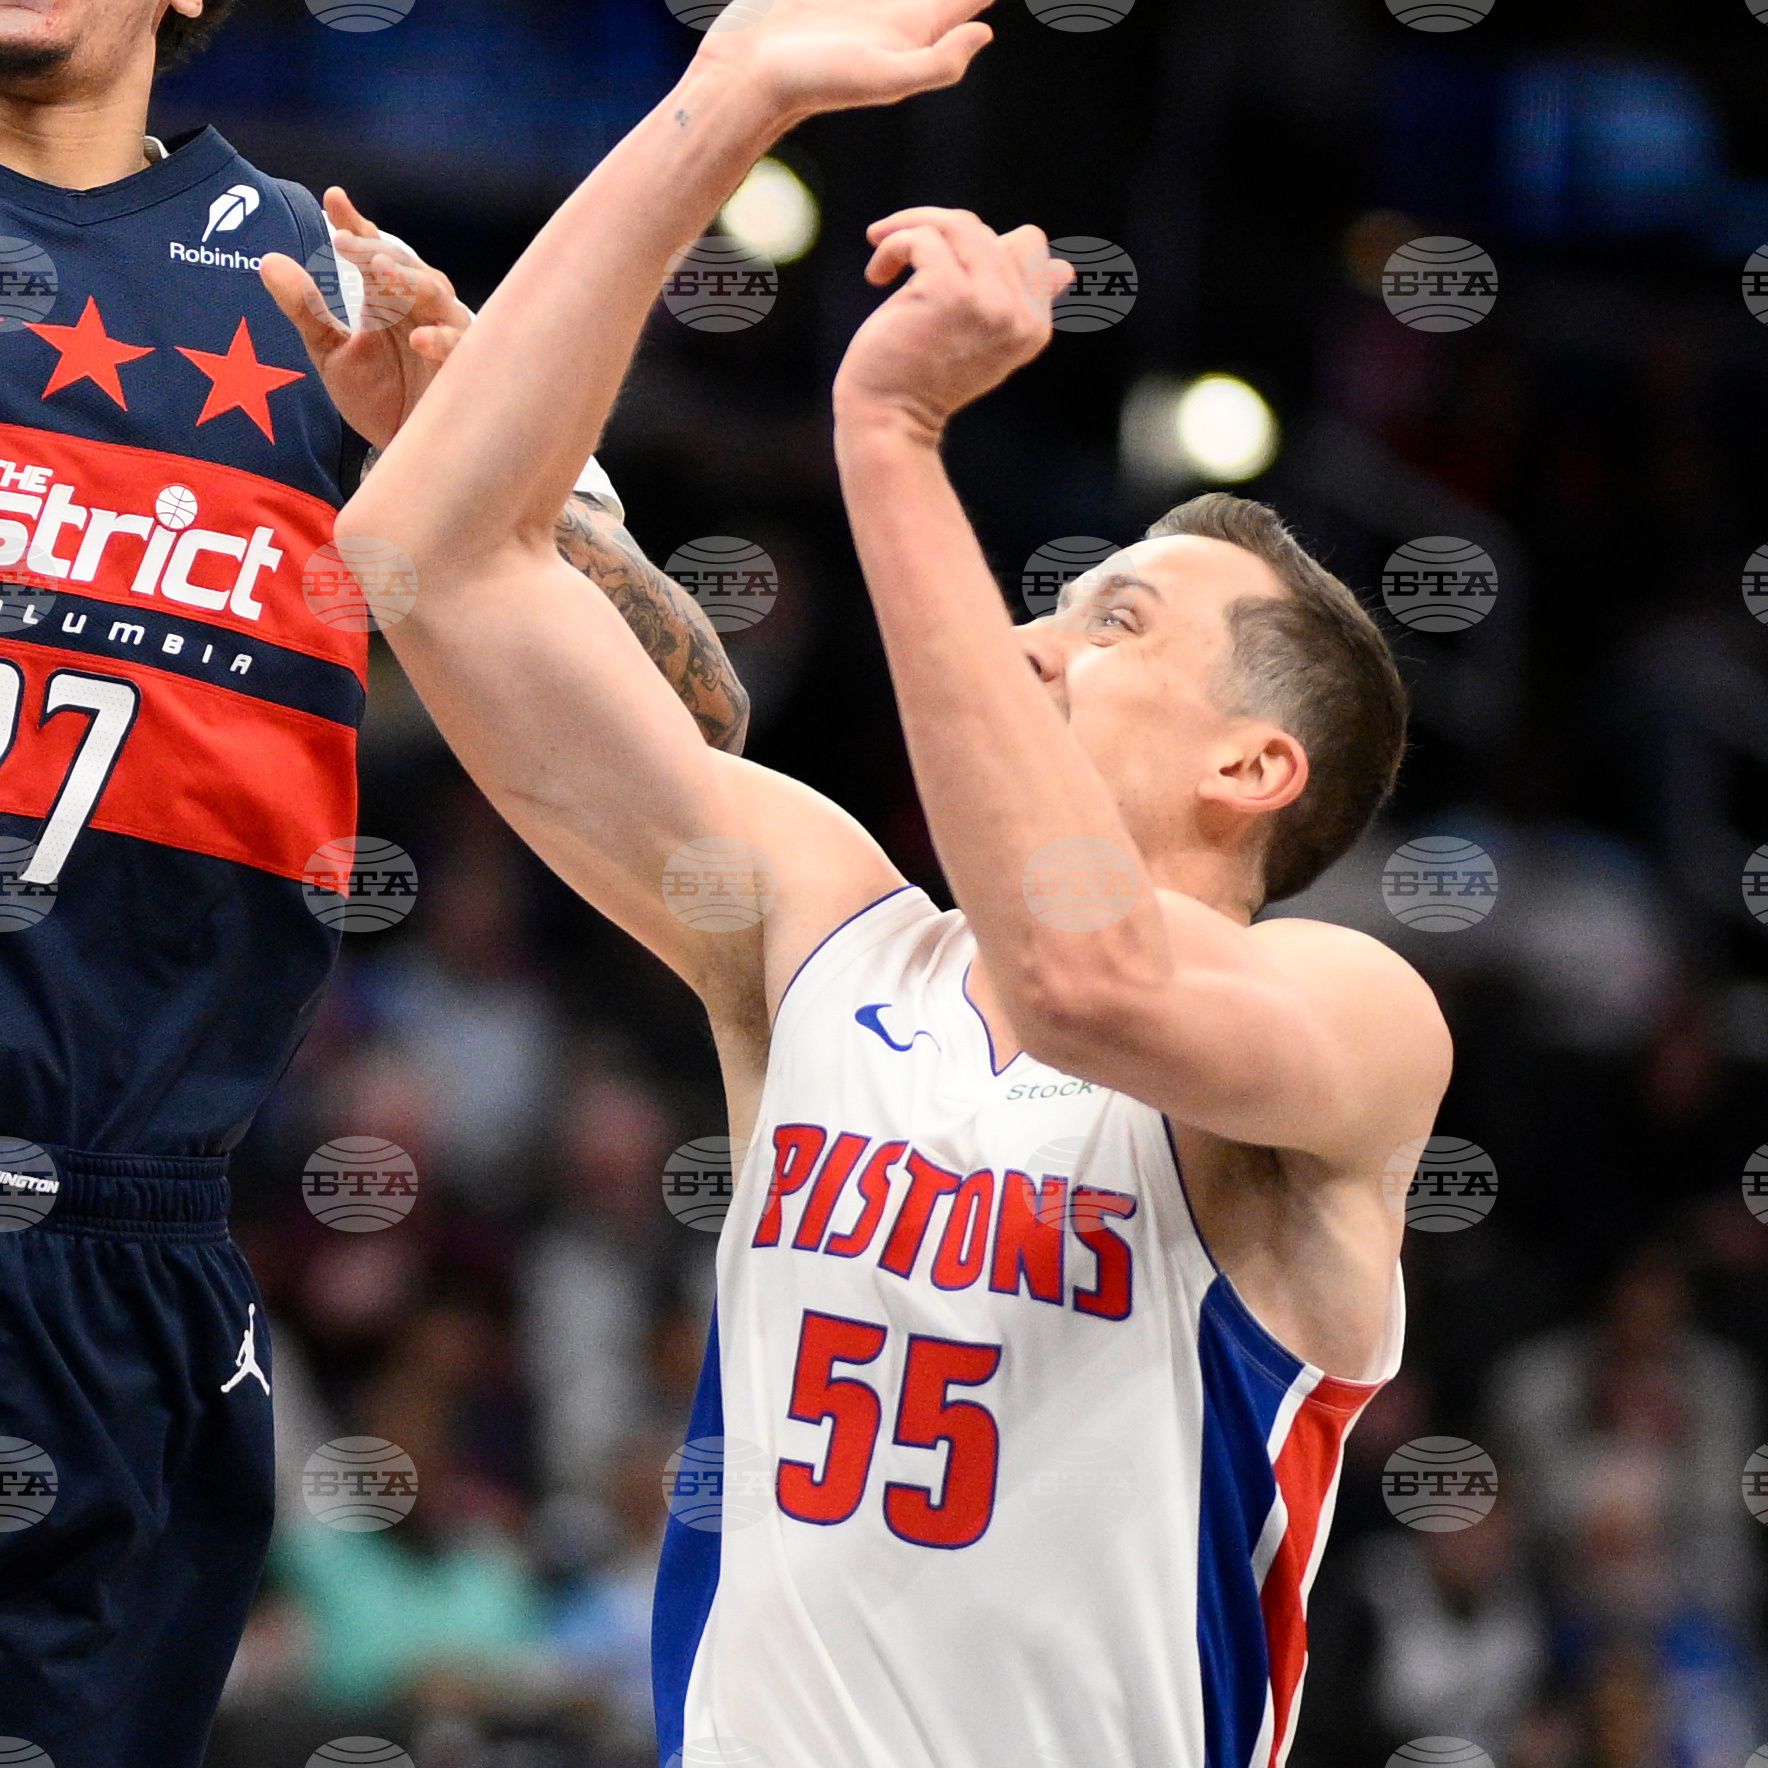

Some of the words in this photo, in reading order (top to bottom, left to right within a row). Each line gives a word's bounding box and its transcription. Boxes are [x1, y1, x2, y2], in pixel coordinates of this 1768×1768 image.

[170, 241, 262, 270] Robinho
[751, 1123, 1137, 1321] PISTONS
[775, 1308, 1002, 1550] 55
